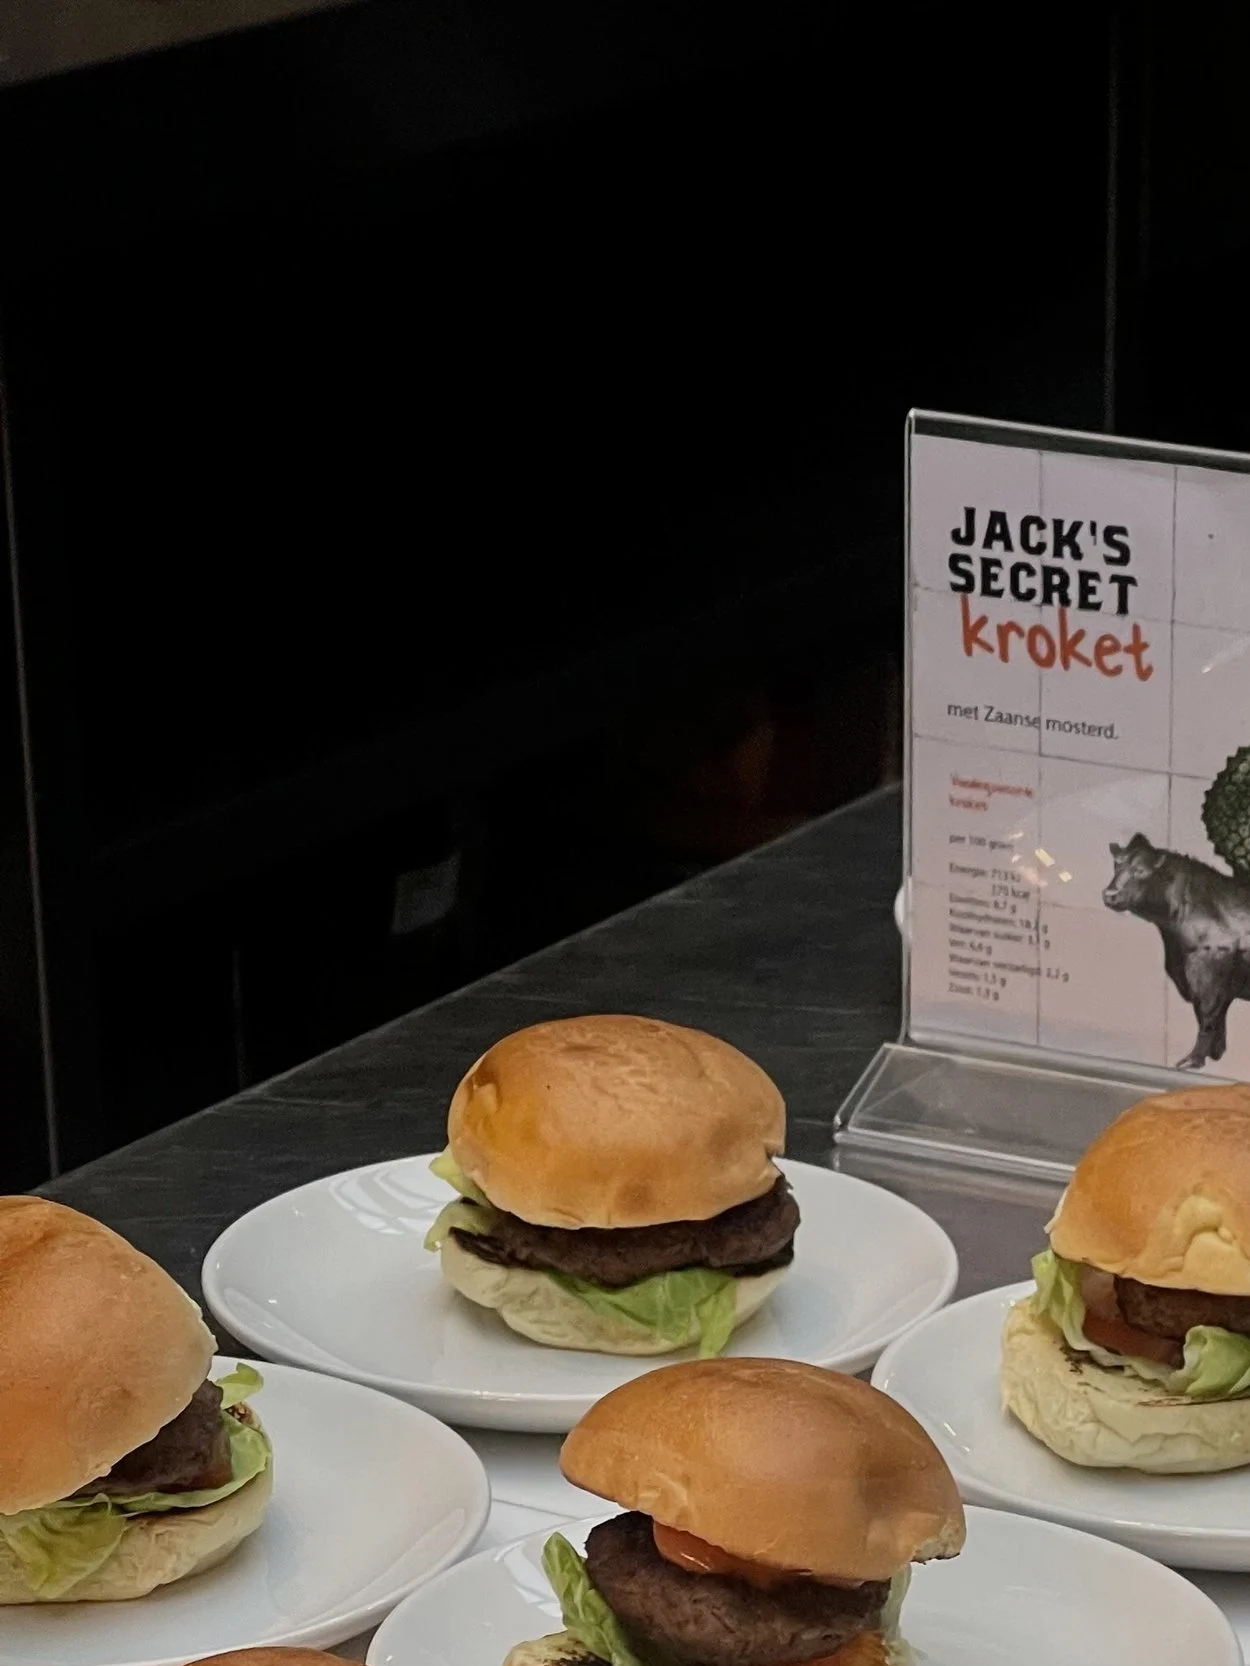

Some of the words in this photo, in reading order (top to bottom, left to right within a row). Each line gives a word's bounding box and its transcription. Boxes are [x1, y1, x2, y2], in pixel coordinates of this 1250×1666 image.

[951, 507, 1131, 566] JACK'S
[949, 553, 1138, 615] SECRET
[960, 594, 1154, 681] kroket
[947, 704, 979, 720] met
[984, 705, 1040, 729] Zaanse
[1046, 718, 1119, 740] mosterd.
